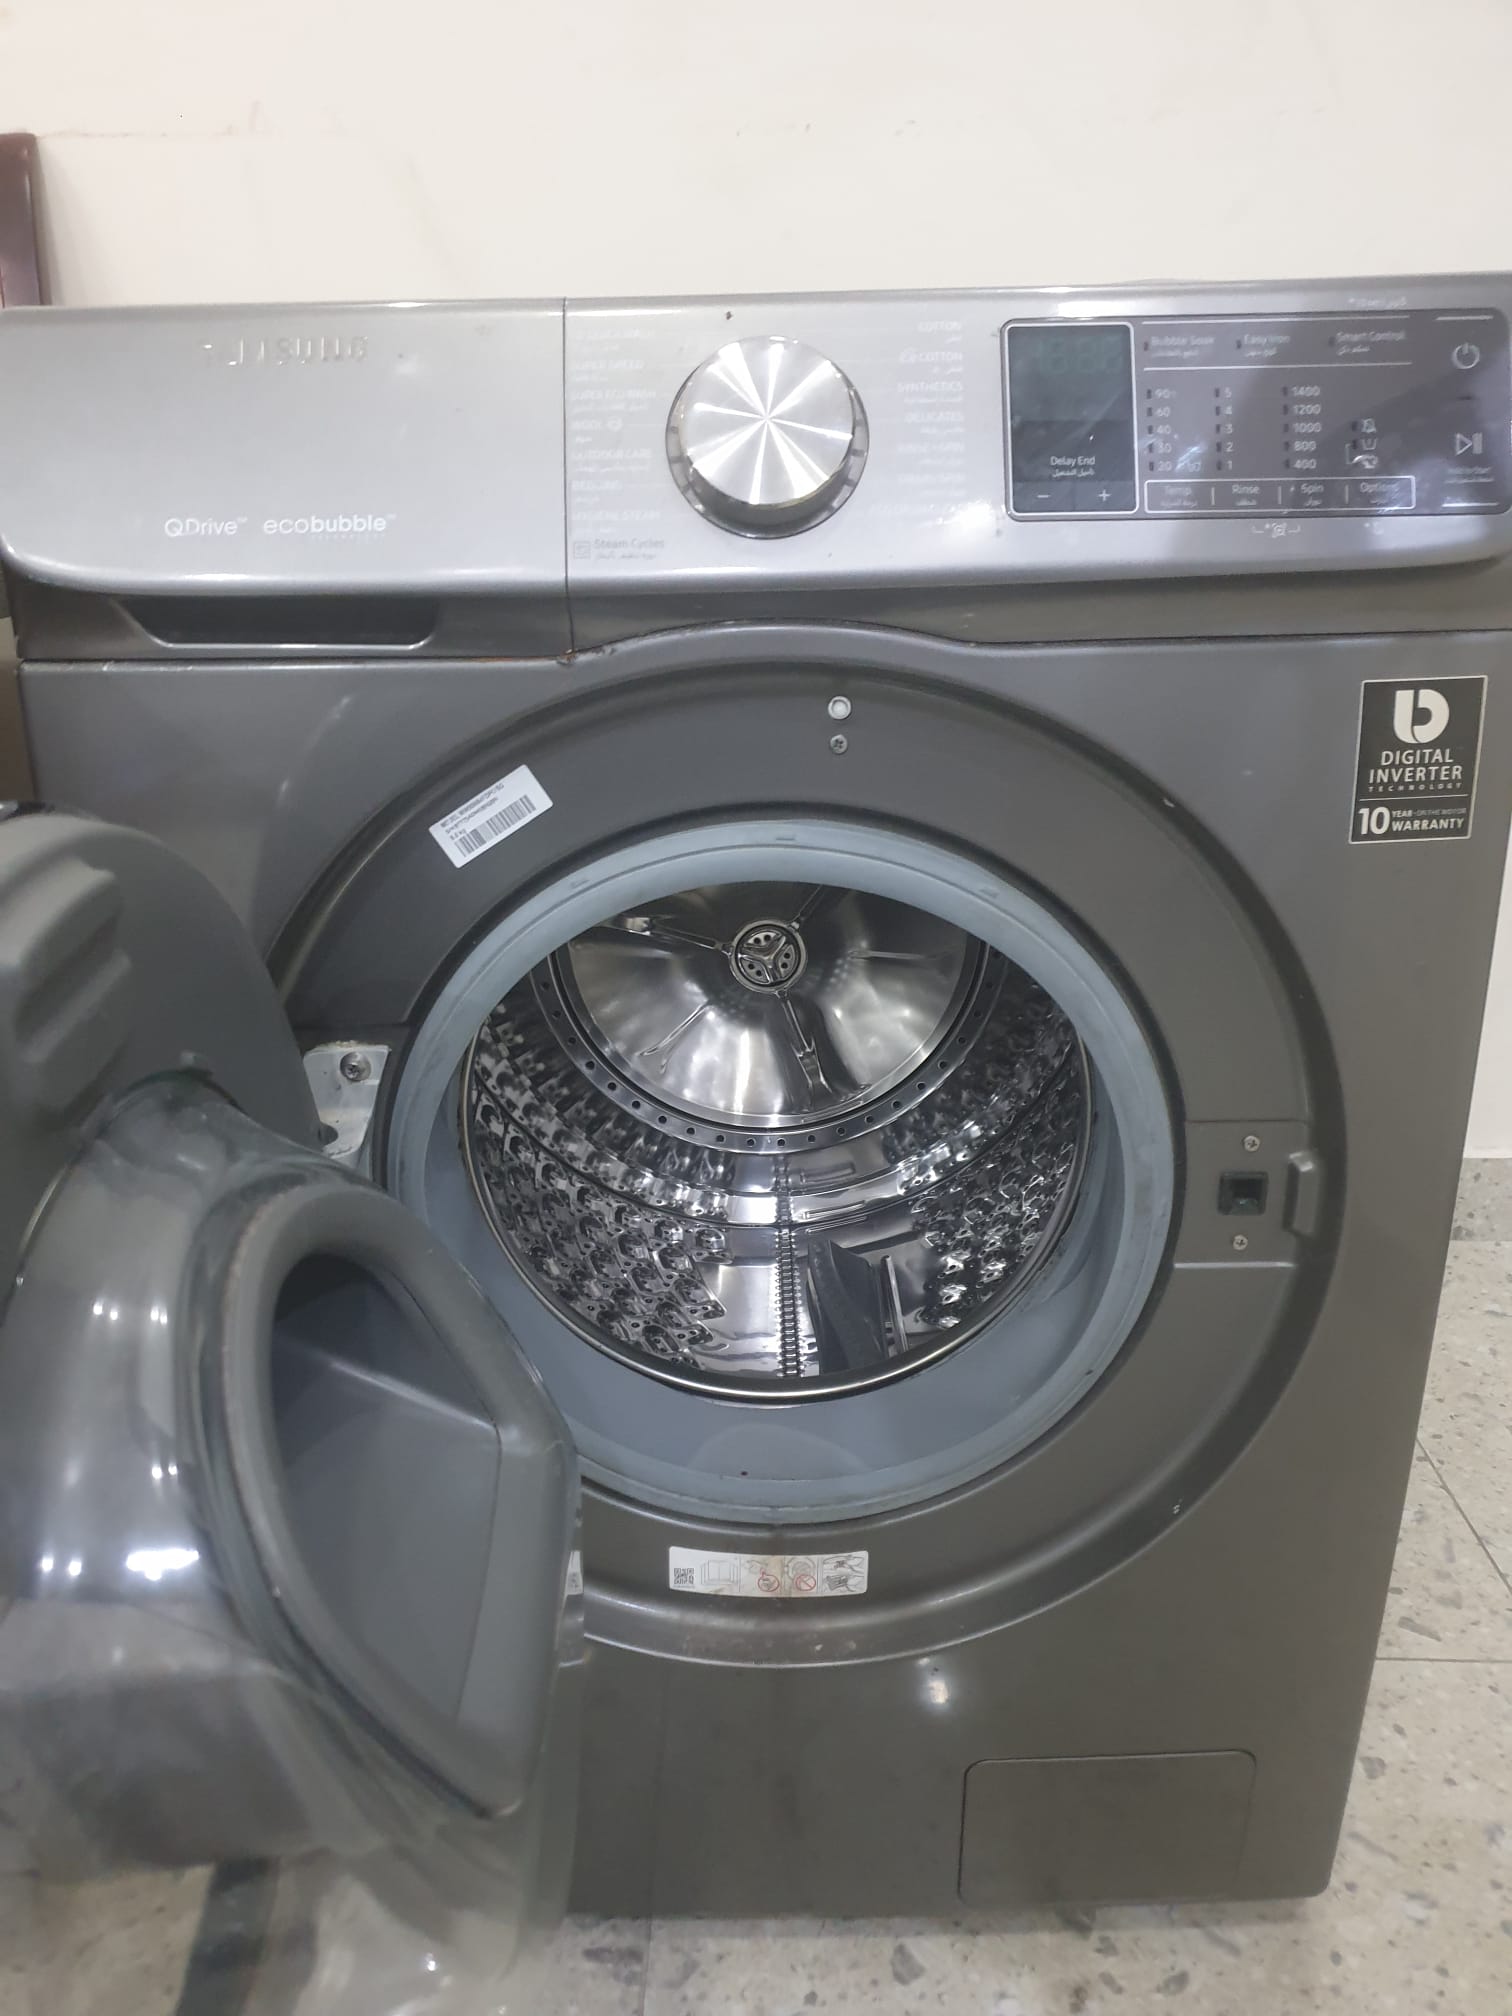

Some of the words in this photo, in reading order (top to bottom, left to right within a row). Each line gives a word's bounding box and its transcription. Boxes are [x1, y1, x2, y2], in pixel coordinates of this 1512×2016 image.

[1292, 385, 1320, 397] 1400
[1293, 404, 1321, 415] 1200
[1224, 424, 1233, 434] 3
[1293, 422, 1321, 433] 1000
[1226, 441, 1234, 452] 2
[1050, 455, 1077, 468] Delay
[1078, 455, 1096, 466] End
[1293, 458, 1317, 469] 400
[1231, 484, 1260, 495] Rinse
[1300, 483, 1325, 495] Spin
[164, 517, 239, 537] QDrive
[263, 514, 388, 535] ecobubble
[1380, 748, 1455, 766] DIGITAL
[1368, 765, 1463, 784] INVERTER
[1367, 782, 1463, 792] TECHNOLOGY
[1357, 806, 1391, 835] 10
[1391, 809, 1414, 818] YEAR
[1391, 818, 1465, 832] WARRANTY
